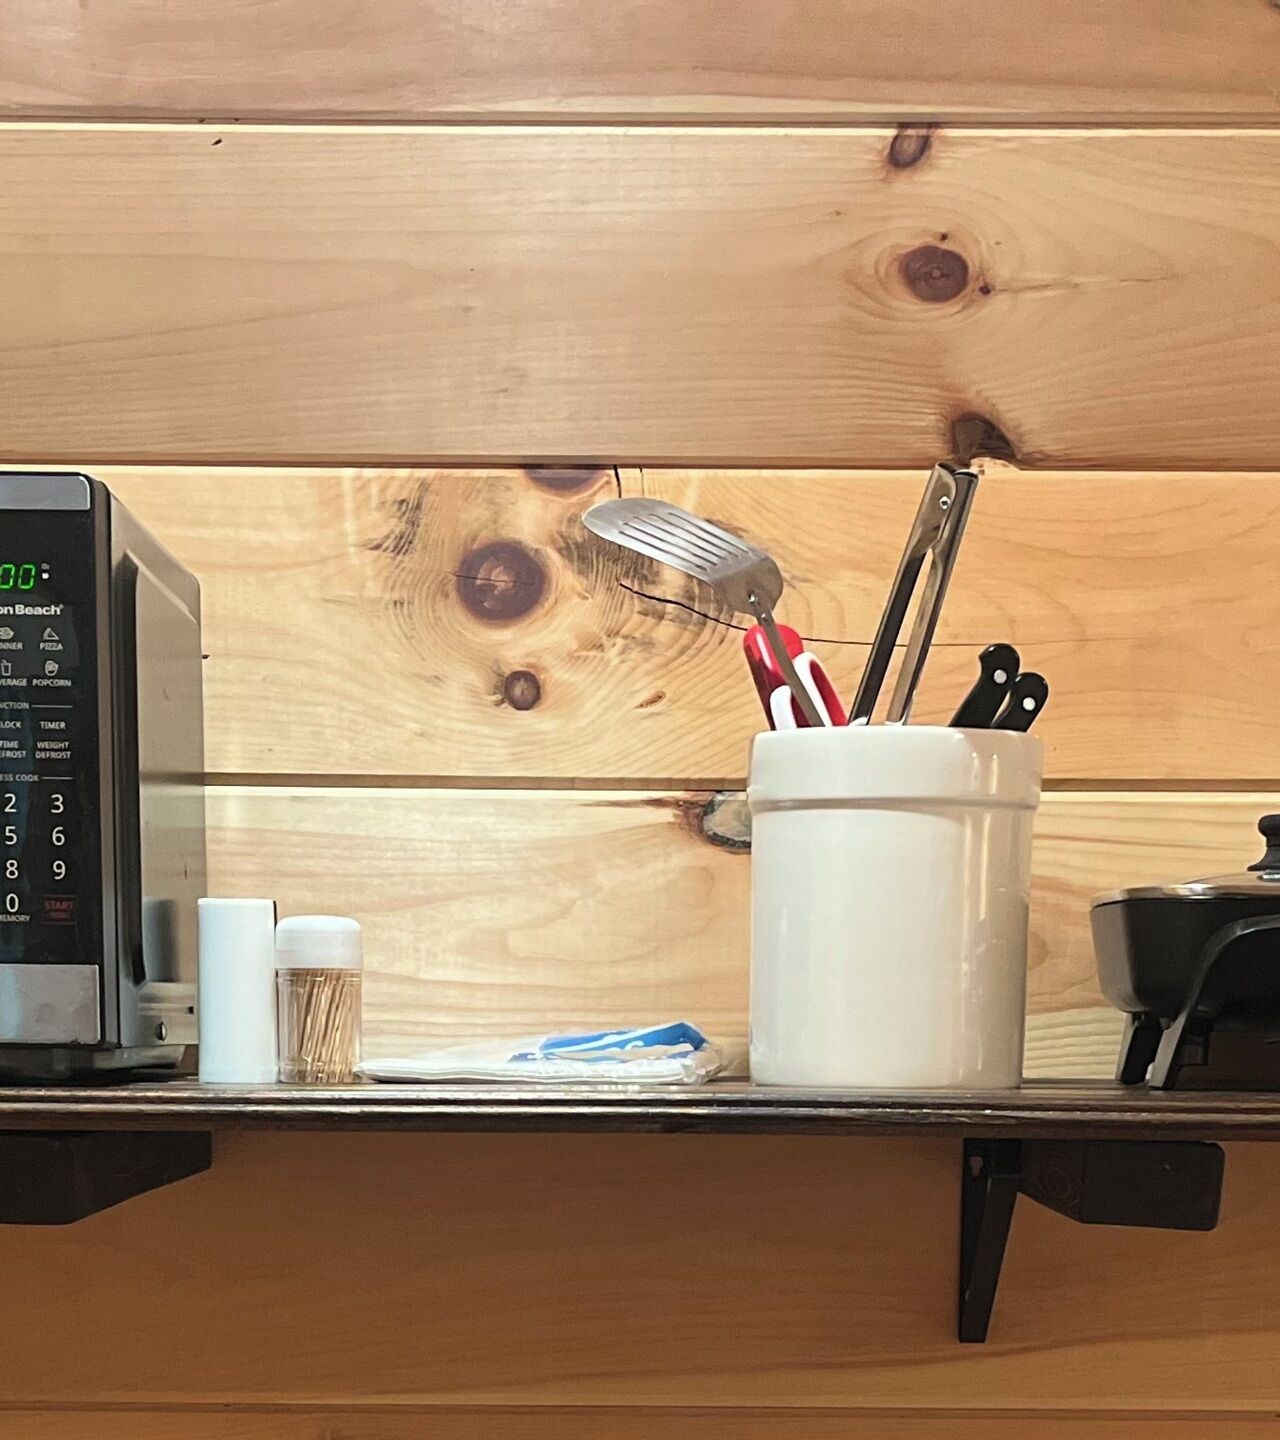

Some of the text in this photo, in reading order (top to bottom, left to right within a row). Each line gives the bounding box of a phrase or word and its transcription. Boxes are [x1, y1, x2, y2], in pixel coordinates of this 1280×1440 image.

[14, 603, 61, 616] Beach
[39, 642, 63, 650] PIZZA
[32, 678, 72, 687] POPCORN
[40, 721, 66, 730] TIMER
[0, 740, 19, 748] TIME
[36, 741, 69, 749] WEIGHT
[35, 751, 71, 759] DEFROST
[15, 774, 40, 782] COOK
[4, 793, 18, 812] 2
[50, 794, 64, 813] 3
[5, 826, 18, 845] 5
[52, 826, 65, 846] 6
[5, 860, 19, 879] 8
[52, 860, 66, 880] 9
[6, 893, 19, 912] 0
